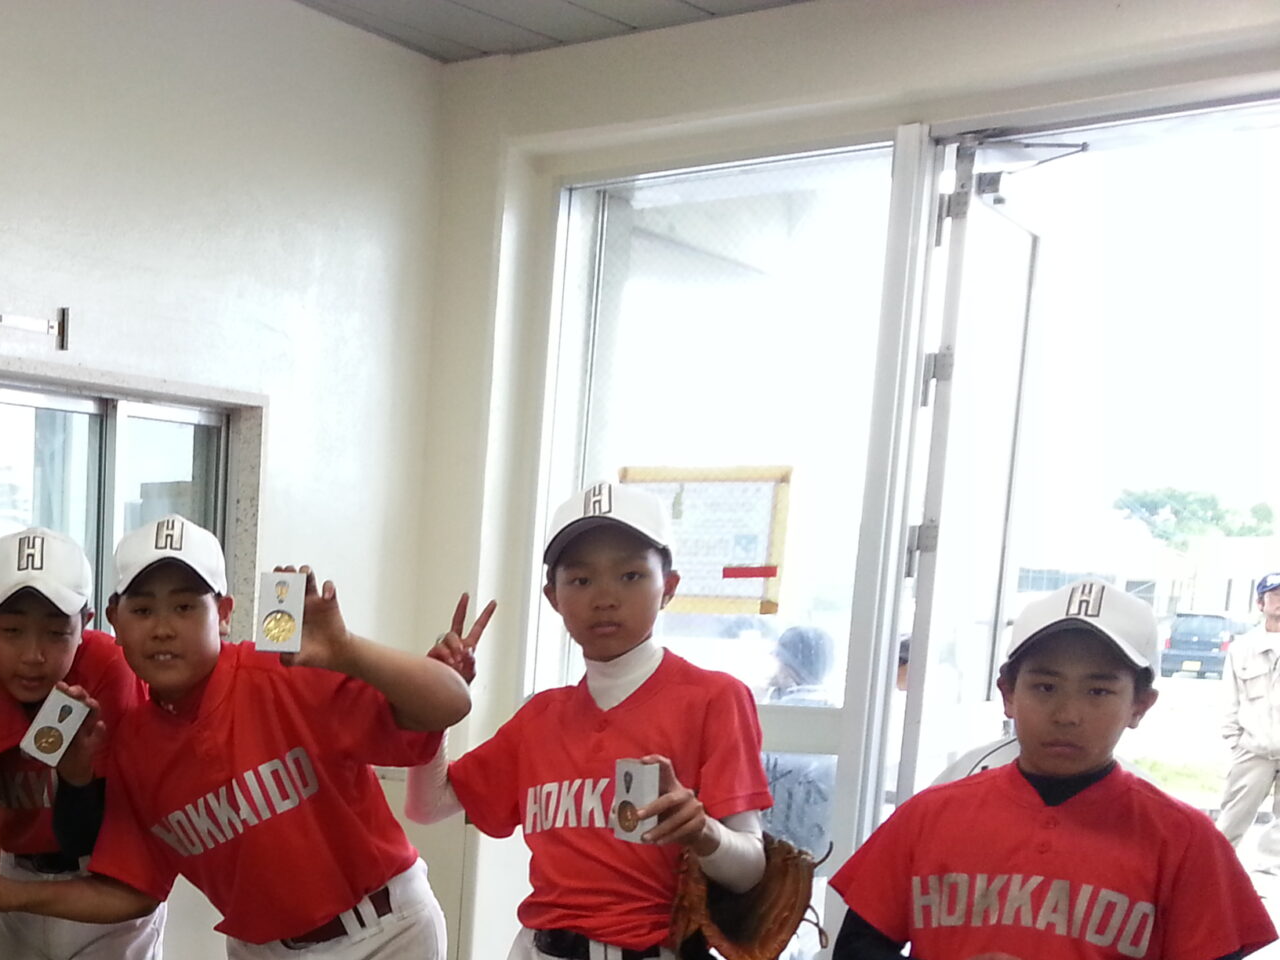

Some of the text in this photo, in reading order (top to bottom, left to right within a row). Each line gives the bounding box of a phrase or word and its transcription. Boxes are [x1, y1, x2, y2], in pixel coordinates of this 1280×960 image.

[583, 483, 612, 517] H
[155, 519, 184, 551] H
[17, 536, 45, 571] H
[1065, 583, 1105, 617] H
[912, 872, 1156, 959] HOKKAIDO
